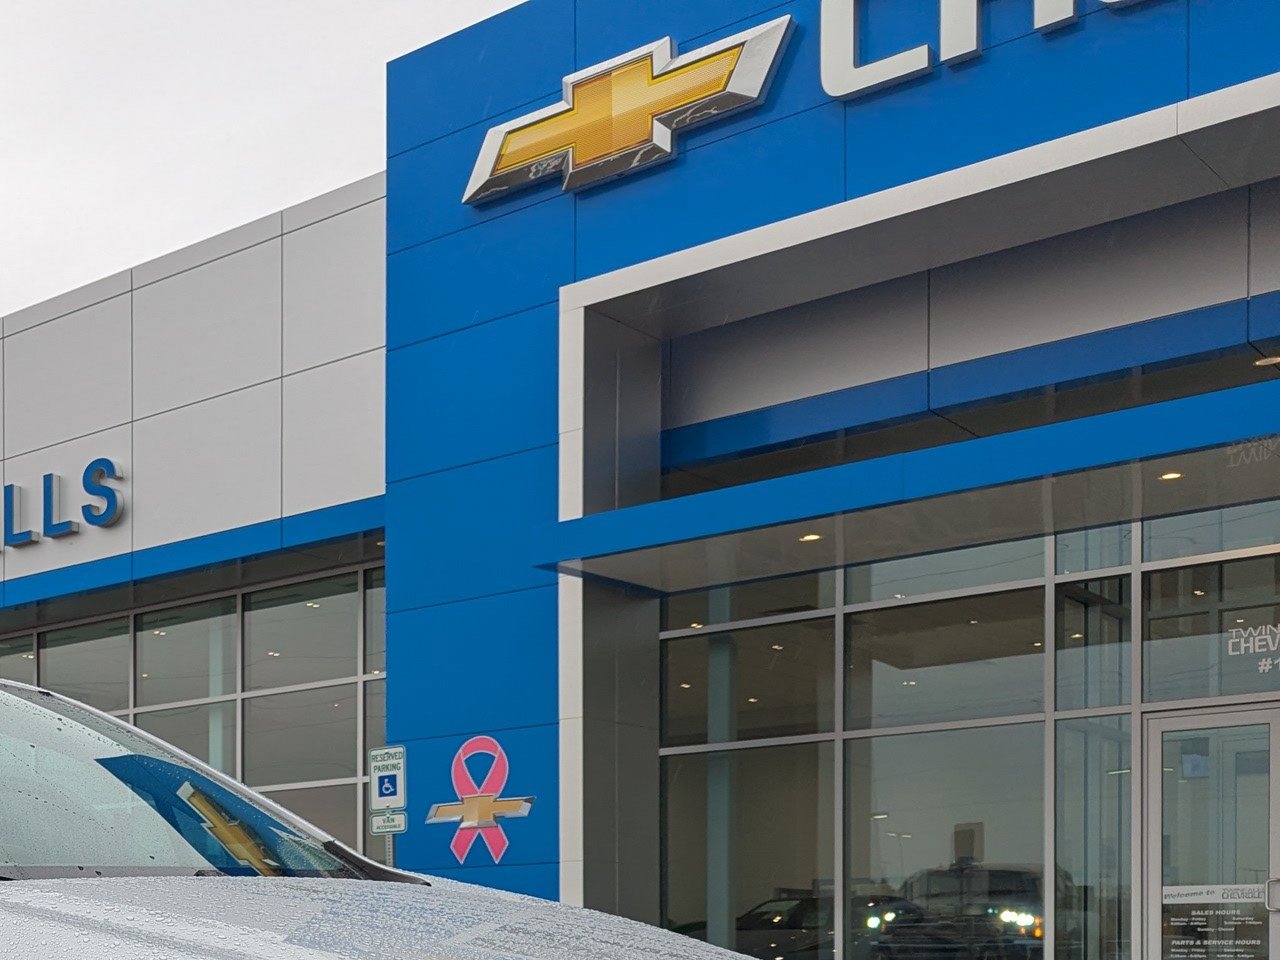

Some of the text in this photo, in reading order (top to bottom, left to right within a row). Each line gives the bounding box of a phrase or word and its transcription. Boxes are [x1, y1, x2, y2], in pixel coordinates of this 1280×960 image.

[1228, 623, 1280, 639] TWIN
[371, 751, 403, 762] RESERVED
[373, 763, 401, 773] PARKING
[382, 816, 395, 824] VAN
